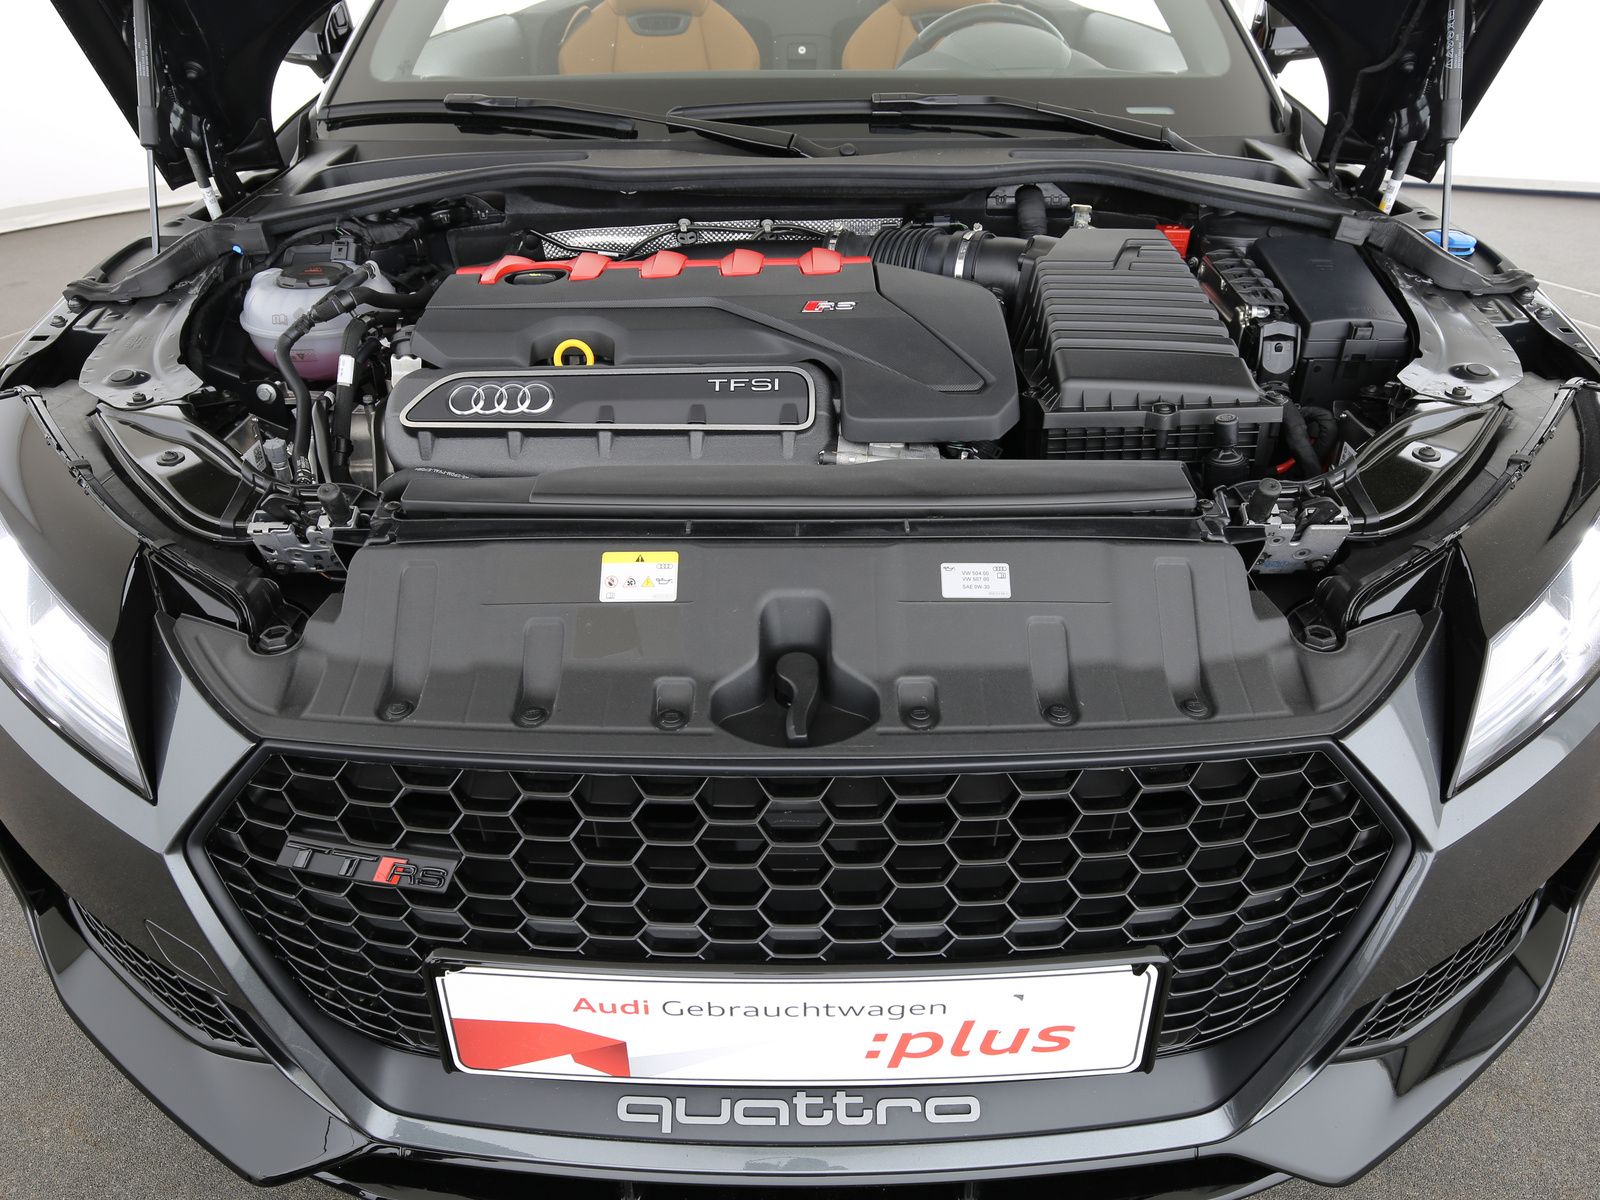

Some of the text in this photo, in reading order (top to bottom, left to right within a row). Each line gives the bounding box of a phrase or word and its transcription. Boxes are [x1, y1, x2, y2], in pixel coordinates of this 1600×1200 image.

[812, 300, 857, 313] RS
[707, 378, 779, 392] TFSI
[286, 840, 448, 889] TT RS
[572, 997, 947, 1021] Audi Gebrauchtwagen
[617, 1091, 981, 1133] quattro
